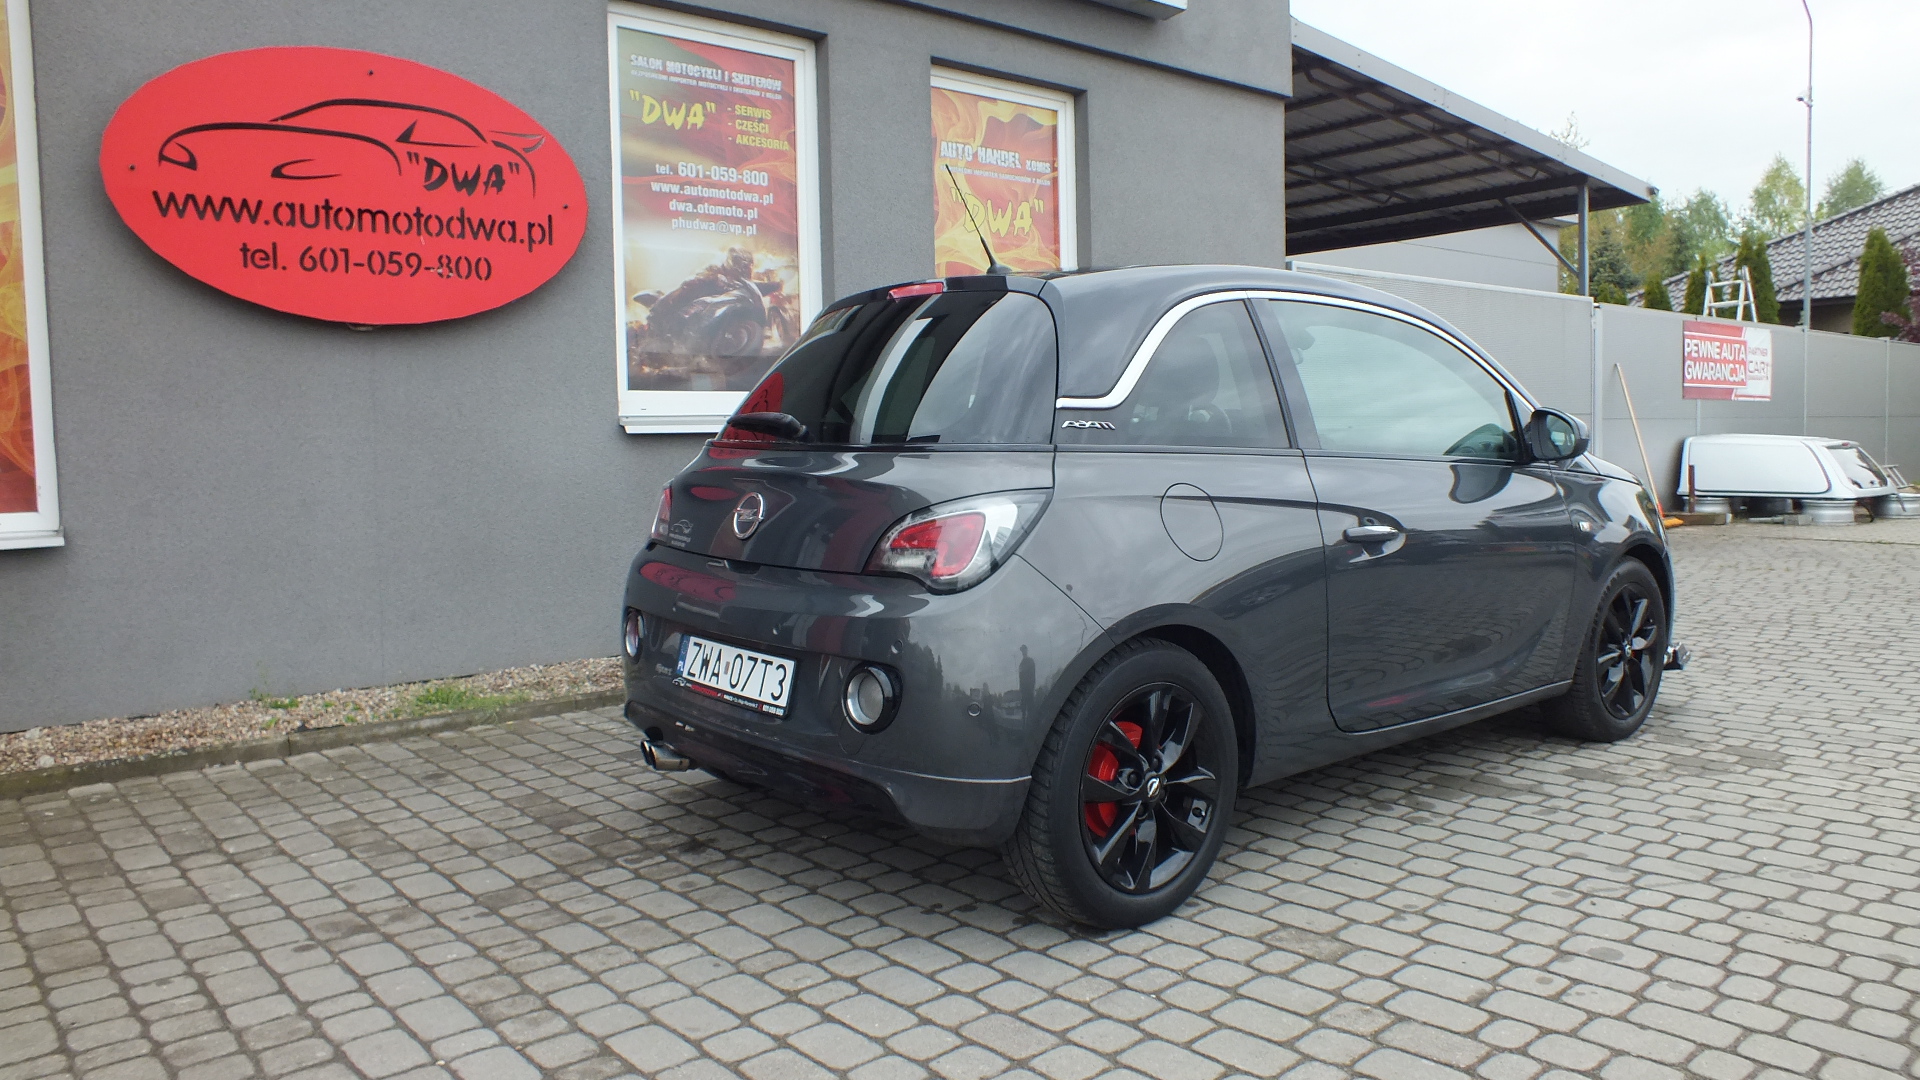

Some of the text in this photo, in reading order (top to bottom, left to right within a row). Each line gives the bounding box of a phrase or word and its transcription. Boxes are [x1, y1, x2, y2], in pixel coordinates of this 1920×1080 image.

[630, 54, 663, 71] SALON
[666, 61, 722, 81] MOTOCYKLI
[724, 70, 730, 83] I
[731, 74, 782, 92] SKUTERÓW
[629, 89, 716, 130] "DWA"
[734, 104, 772, 120] SERWIS
[735, 118, 770, 135] CZĘŚCI
[735, 134, 790, 151] AKCESORIA
[941, 141, 1052, 174] AUTO HANDEL KOMIS
[407, 151, 520, 196] "DWA"
[655, 161, 769, 187] tel. 601-059-800
[651, 181, 773, 206] www.automotodwa.pl
[152, 189, 554, 253] www.automotodwa.pl
[669, 199, 759, 220] dwa.otomoto.pl
[672, 217, 757, 236] phudwa@vp.pl
[240, 242, 492, 282] tel. 601-059-800
[1684, 338, 1746, 362] PEWNE AUTA
[1684, 360, 1746, 382] GWARANCJA
[687, 641, 723, 686] ZWA
